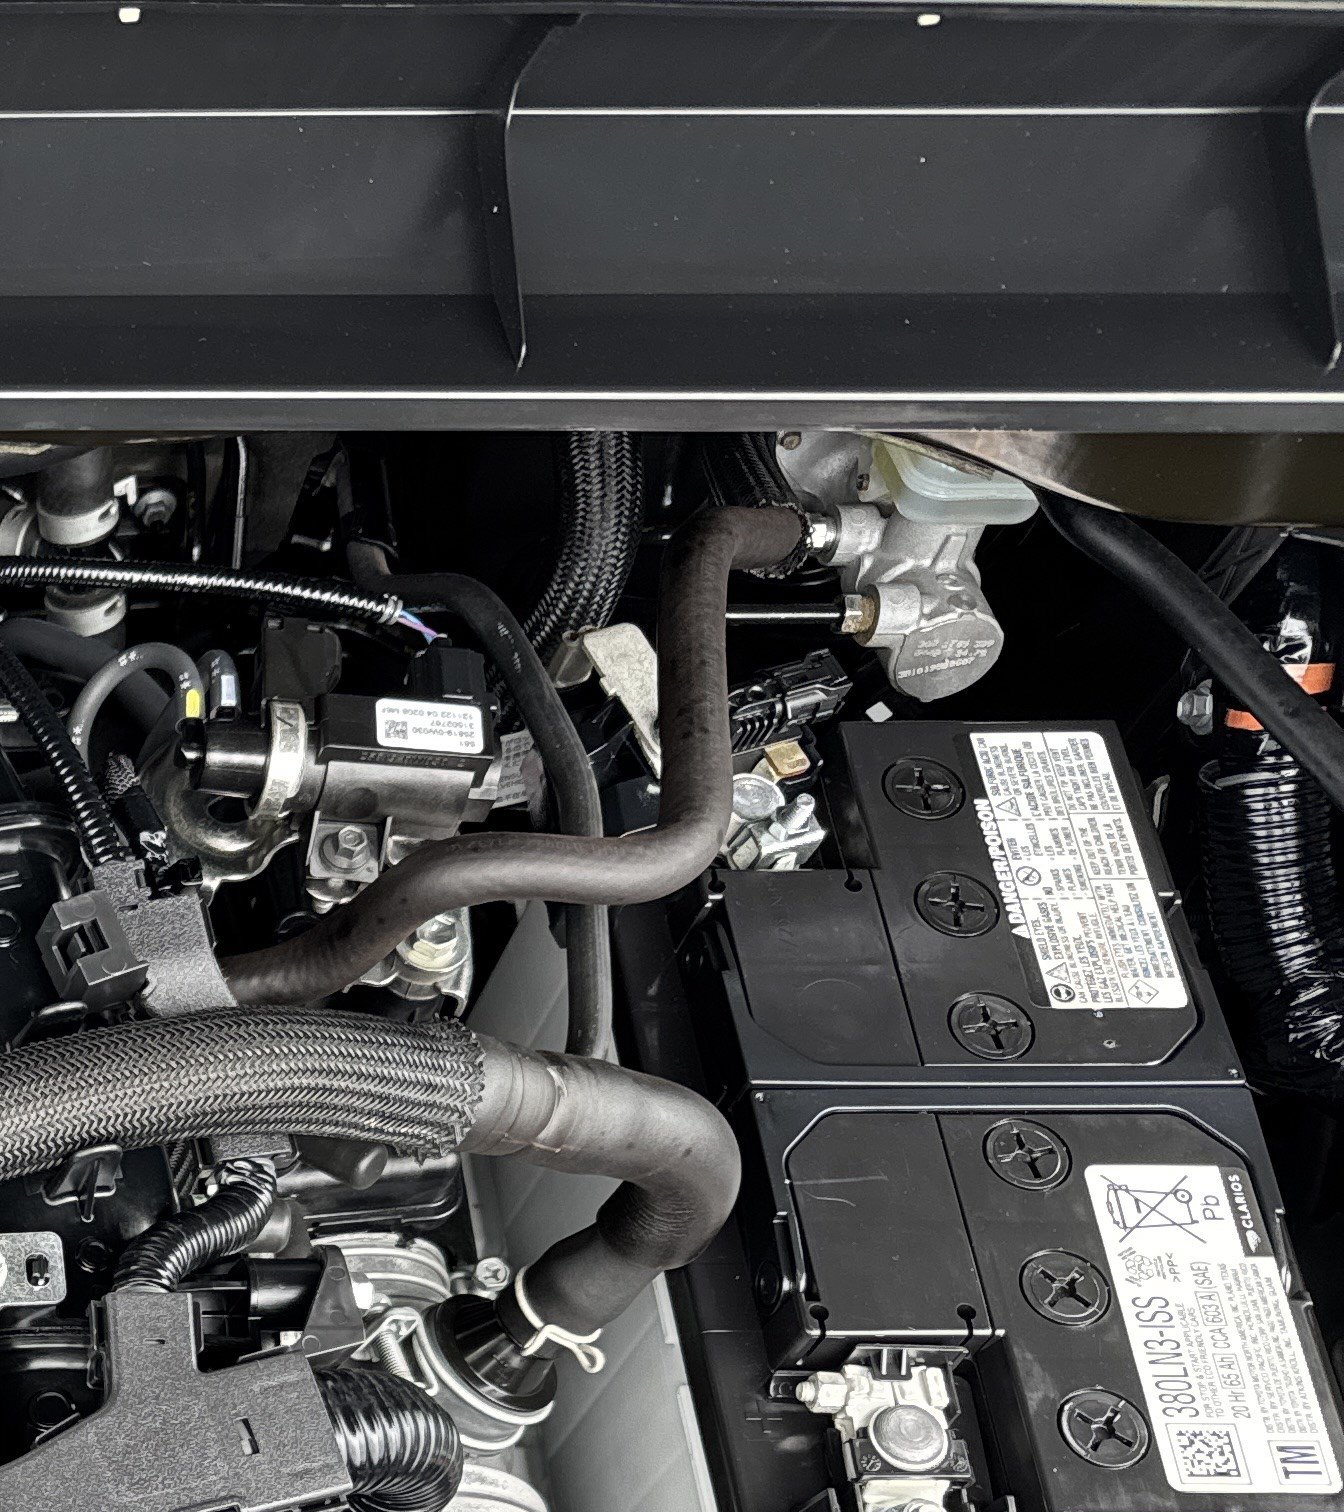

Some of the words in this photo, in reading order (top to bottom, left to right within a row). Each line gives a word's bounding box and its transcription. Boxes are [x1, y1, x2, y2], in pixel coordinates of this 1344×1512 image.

[973, 798, 1025, 923] DANGER/POISON
[1197, 1195, 1224, 1219] Pb
[1227, 1174, 1255, 1228] CLARIOS
[1189, 1261, 1217, 1288] (SAE)
[1201, 1303, 1223, 1322] 603
[1208, 1327, 1230, 1348] CCA
[1130, 1296, 1200, 1417] 380LN3-ISS
[1187, 1349, 1201, 1372] START
[1215, 1356, 1236, 1370] Ah
[1221, 1373, 1240, 1386] 65
[1197, 1382, 1210, 1401] STOP
[1227, 1389, 1245, 1402] Hr
[1231, 1405, 1251, 1418] 20
[1275, 1443, 1322, 1479] TM
